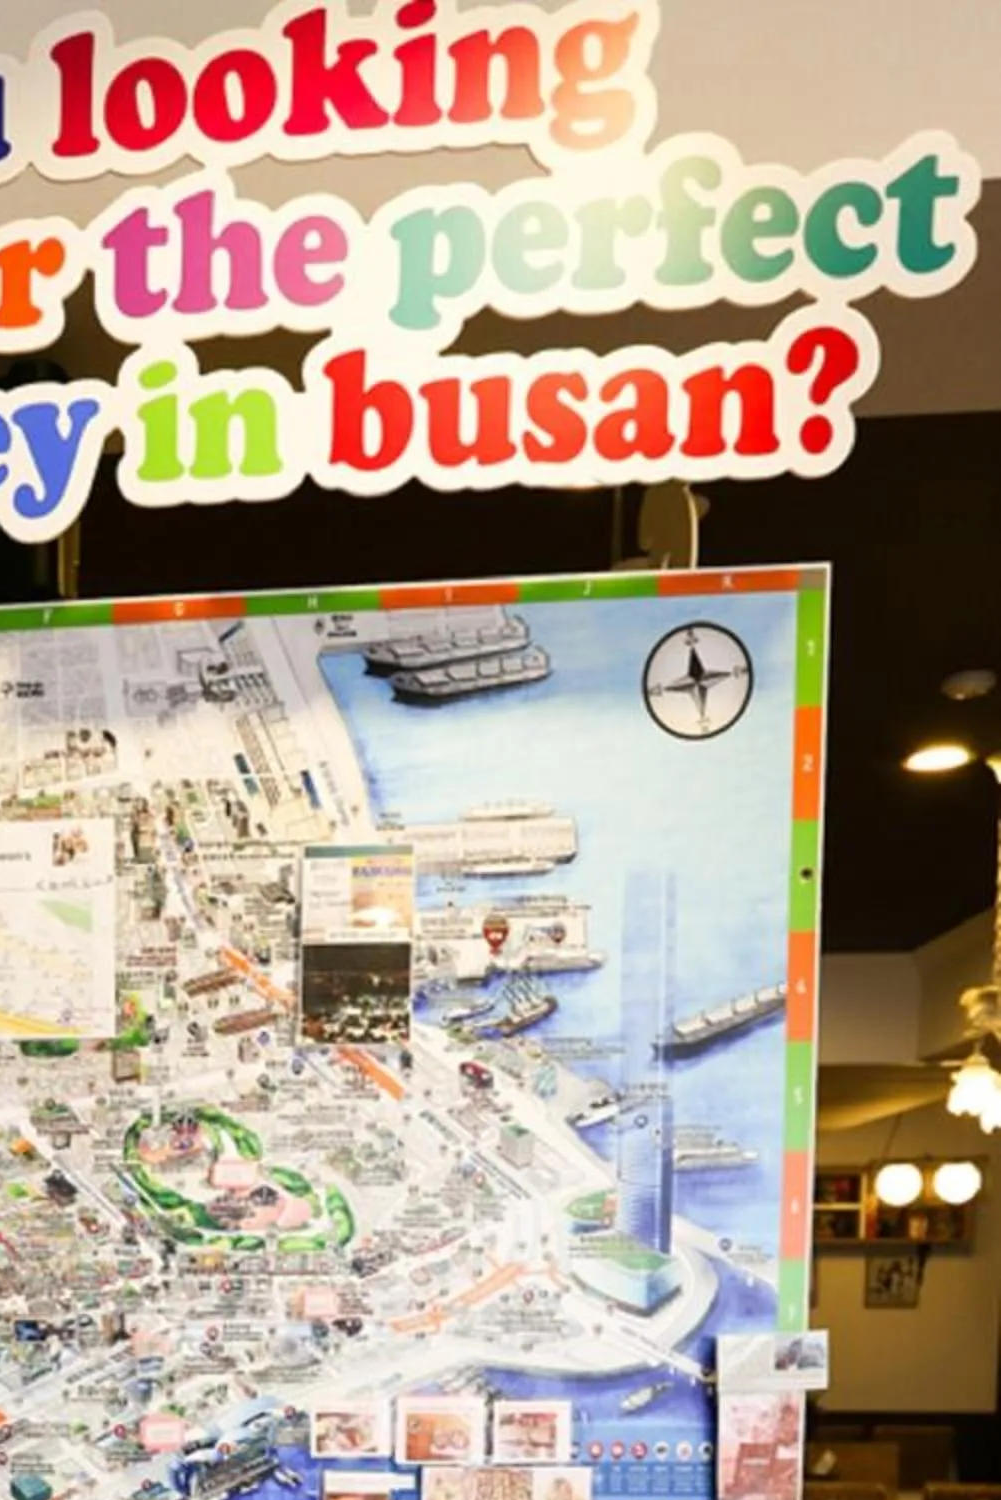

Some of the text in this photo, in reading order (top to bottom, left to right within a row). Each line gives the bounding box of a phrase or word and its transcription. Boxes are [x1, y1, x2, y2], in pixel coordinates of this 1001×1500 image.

[50, 0, 640, 159] looking
[102, 190, 349, 320] the
[389, 153, 960, 331] perfect
[137, 360, 284, 484] in
[323, 326, 860, 471] busan?
